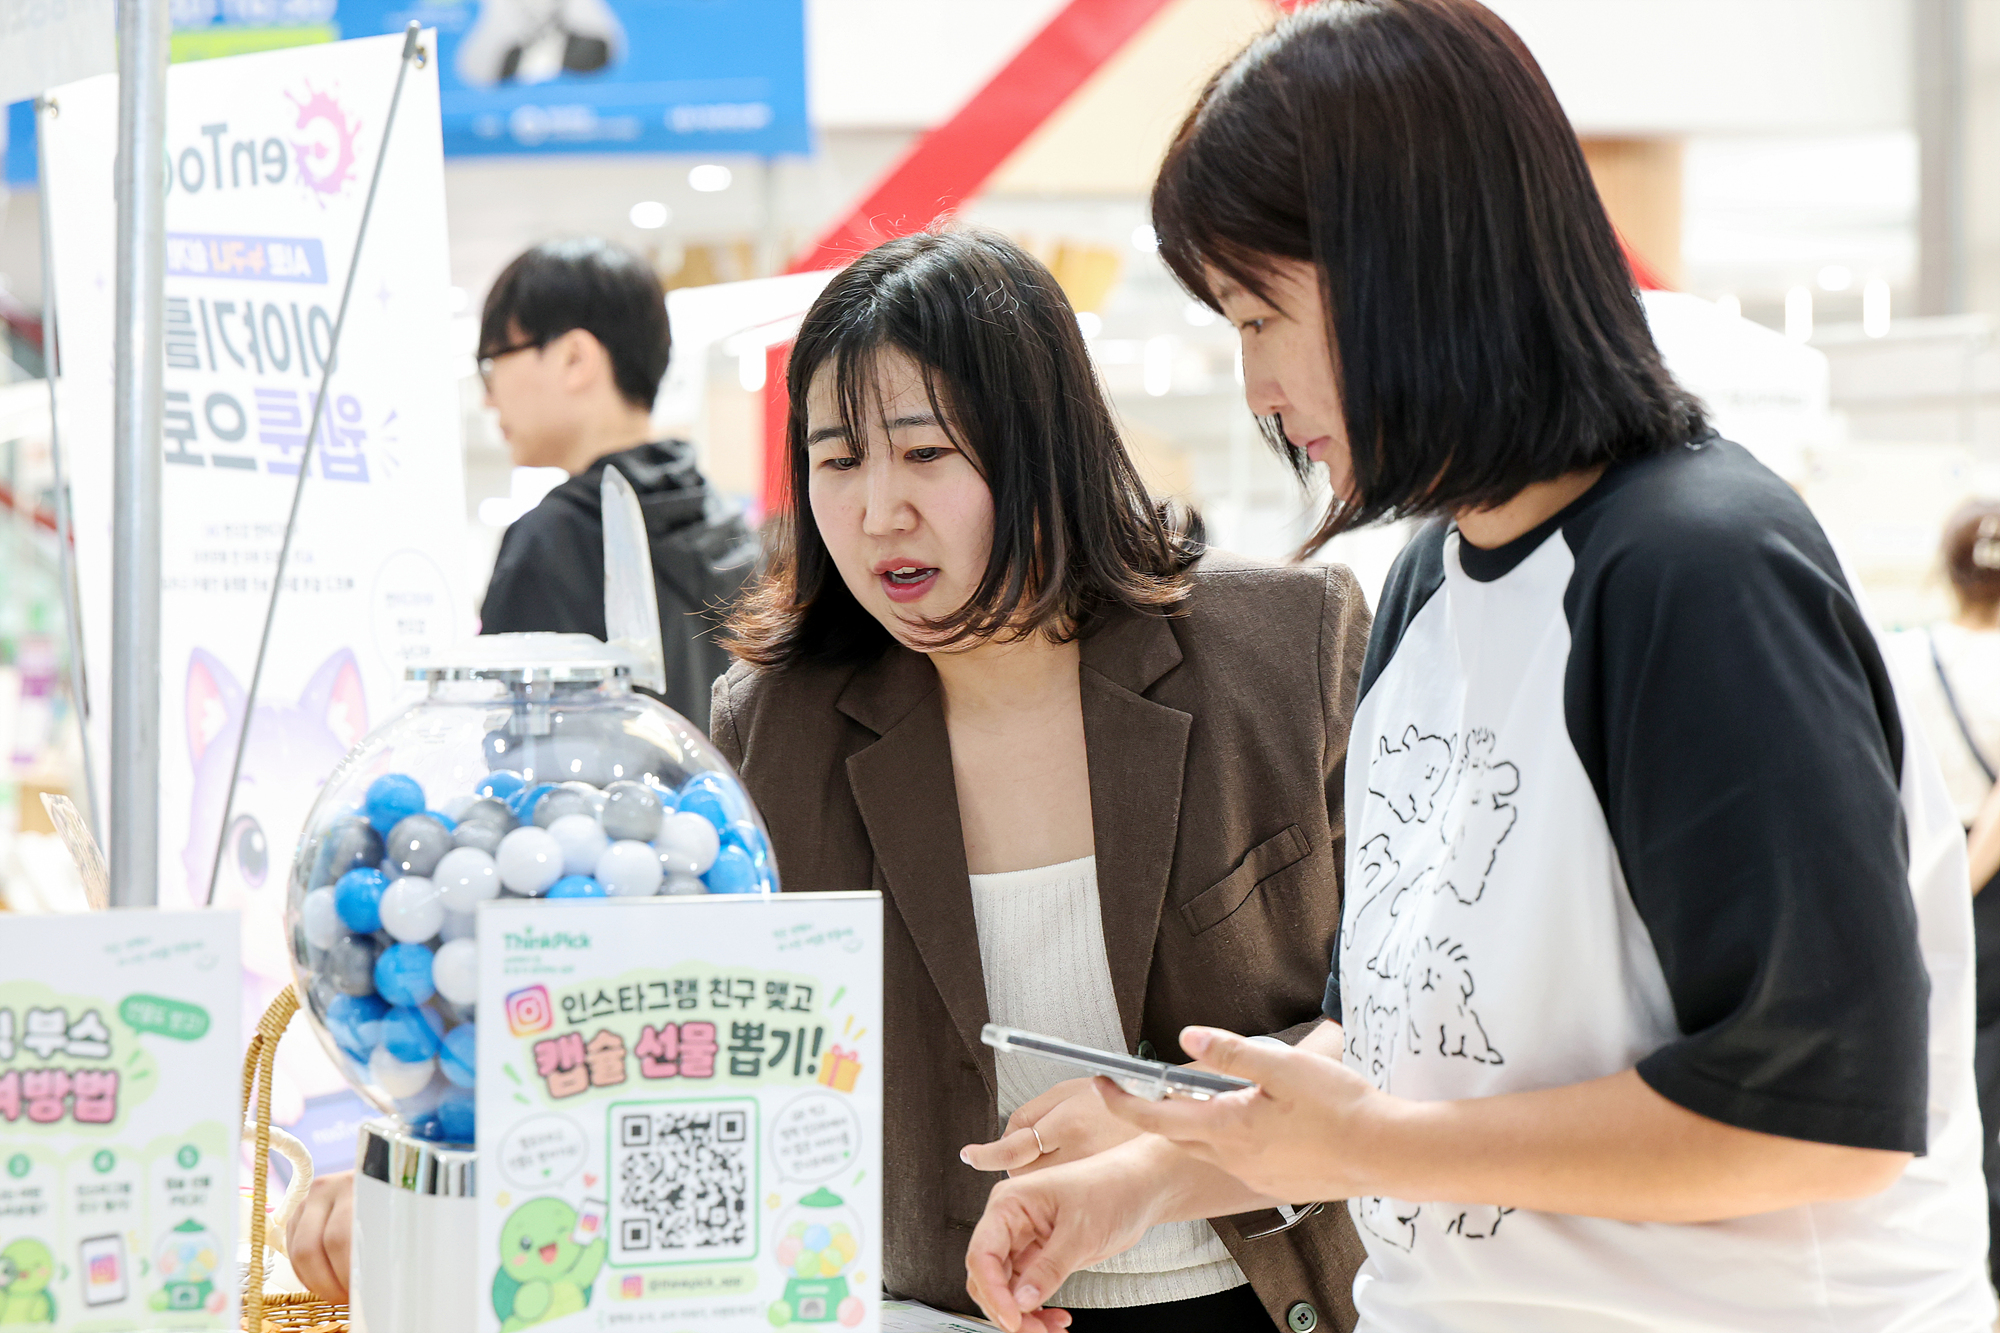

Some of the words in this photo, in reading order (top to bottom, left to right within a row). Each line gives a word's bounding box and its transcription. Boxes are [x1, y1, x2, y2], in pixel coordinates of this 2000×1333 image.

[503, 924, 593, 950] ThinkPick
[561, 979, 698, 1025] 인스타그램
[707, 978, 757, 1009] 친구
[764, 980, 814, 1012] 맺고
[23, 1006, 112, 1060] 부스
[532, 1029, 627, 1099] 캡슐
[634, 1021, 719, 1079] 선물
[727, 1020, 825, 1077] 뽑기!
